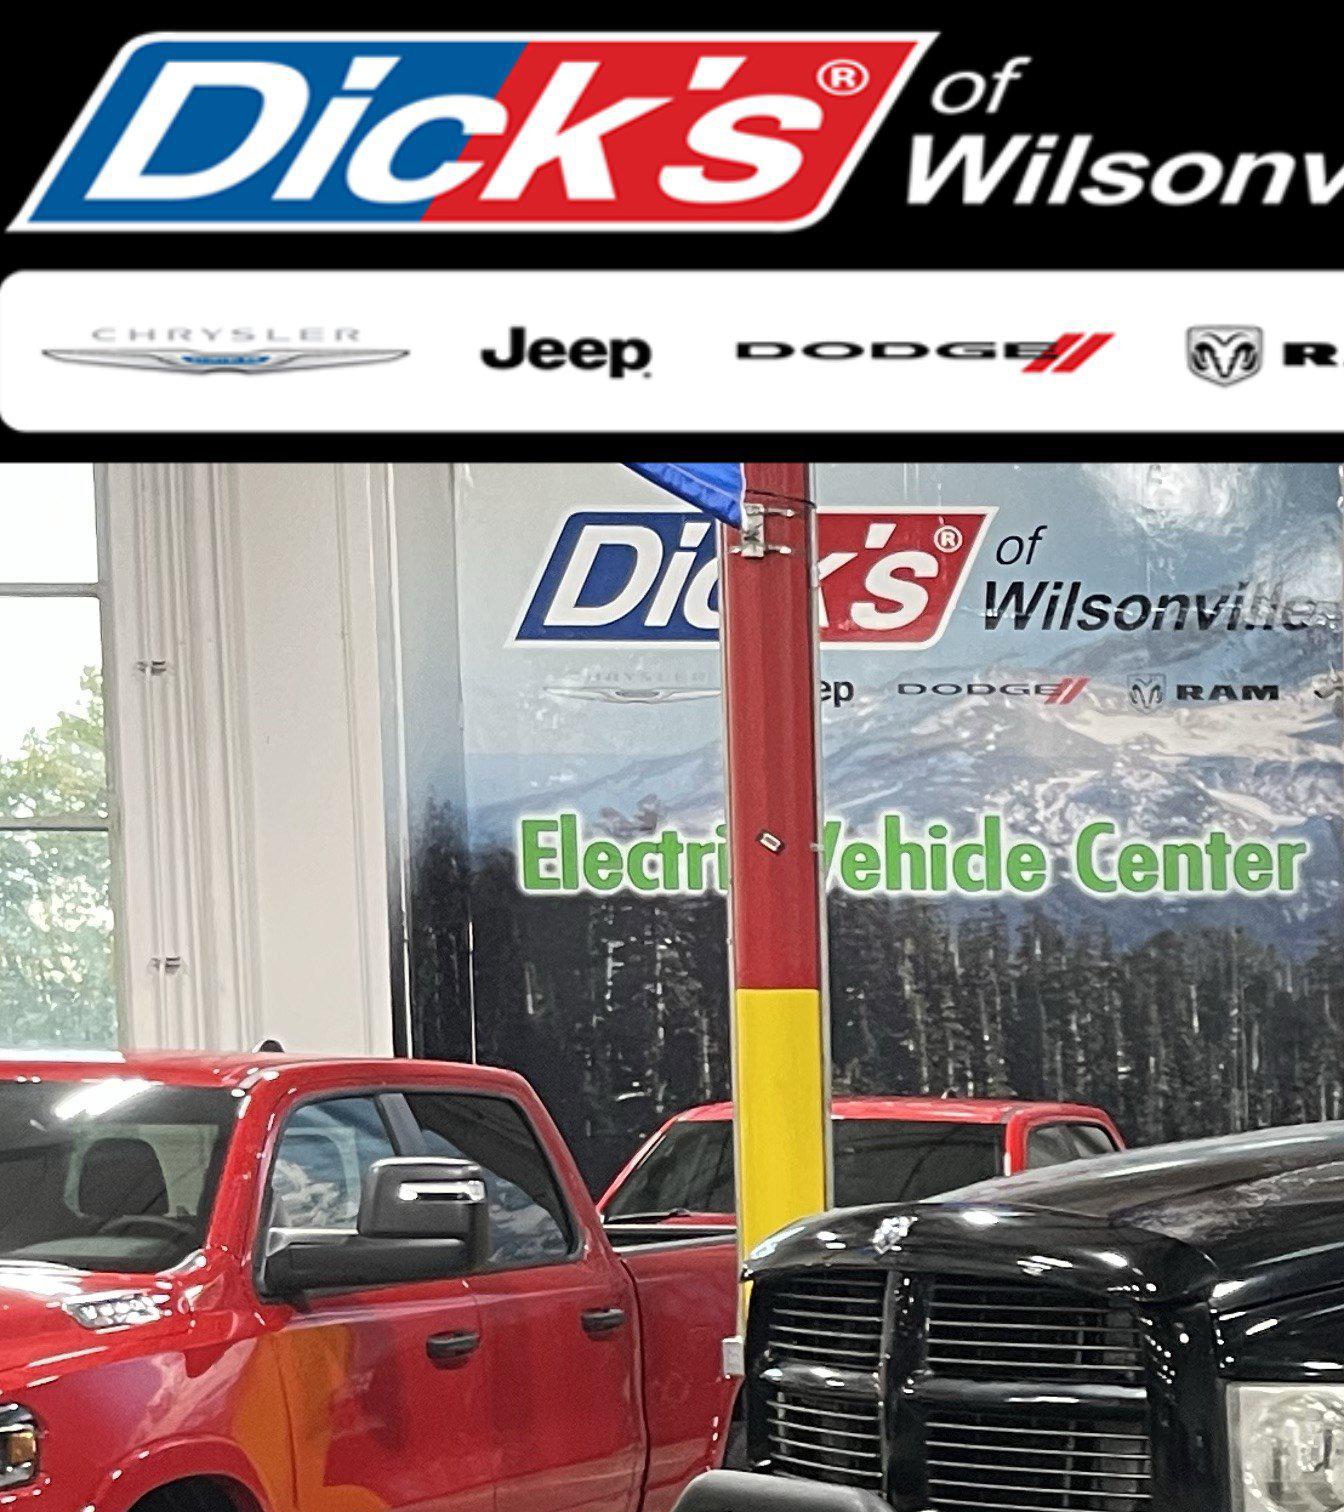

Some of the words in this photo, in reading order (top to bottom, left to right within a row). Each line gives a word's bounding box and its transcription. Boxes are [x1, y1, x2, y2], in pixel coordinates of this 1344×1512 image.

[996, 525, 1047, 565] of
[897, 682, 1060, 696] DODGE
[1176, 683, 1280, 701] RAM
[1076, 821, 1307, 893] Center
